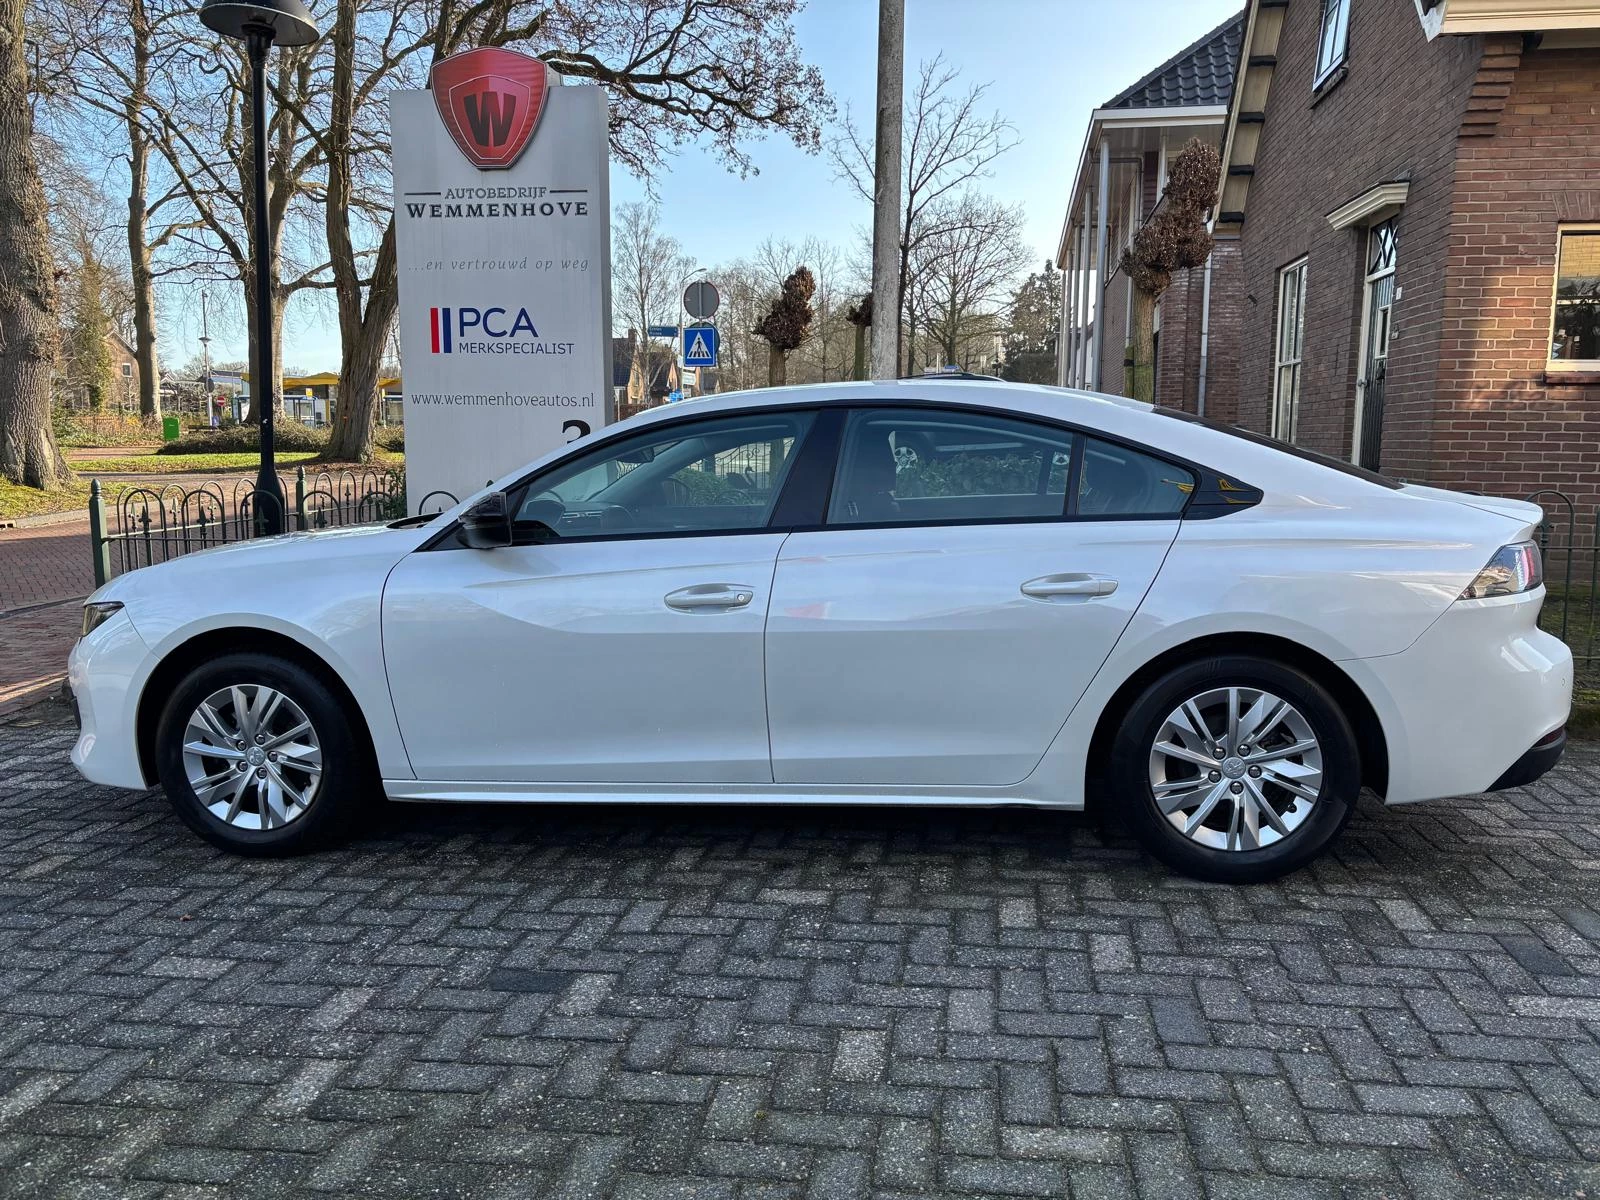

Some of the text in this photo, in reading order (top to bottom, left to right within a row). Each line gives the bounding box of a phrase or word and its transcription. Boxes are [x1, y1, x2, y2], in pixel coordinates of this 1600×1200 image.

[463, 91, 516, 146] W
[444, 187, 547, 199] AUTOBEDRIJF
[405, 202, 588, 218] WEMMENHOVE
[451, 257, 527, 270] vertrouwd
[535, 260, 553, 271] op
[561, 259, 589, 271] weg
[459, 307, 538, 338] PCA
[459, 342, 575, 355] MERKSPECIALIST
[411, 392, 595, 408] www.wemmenhoveautos.nl
